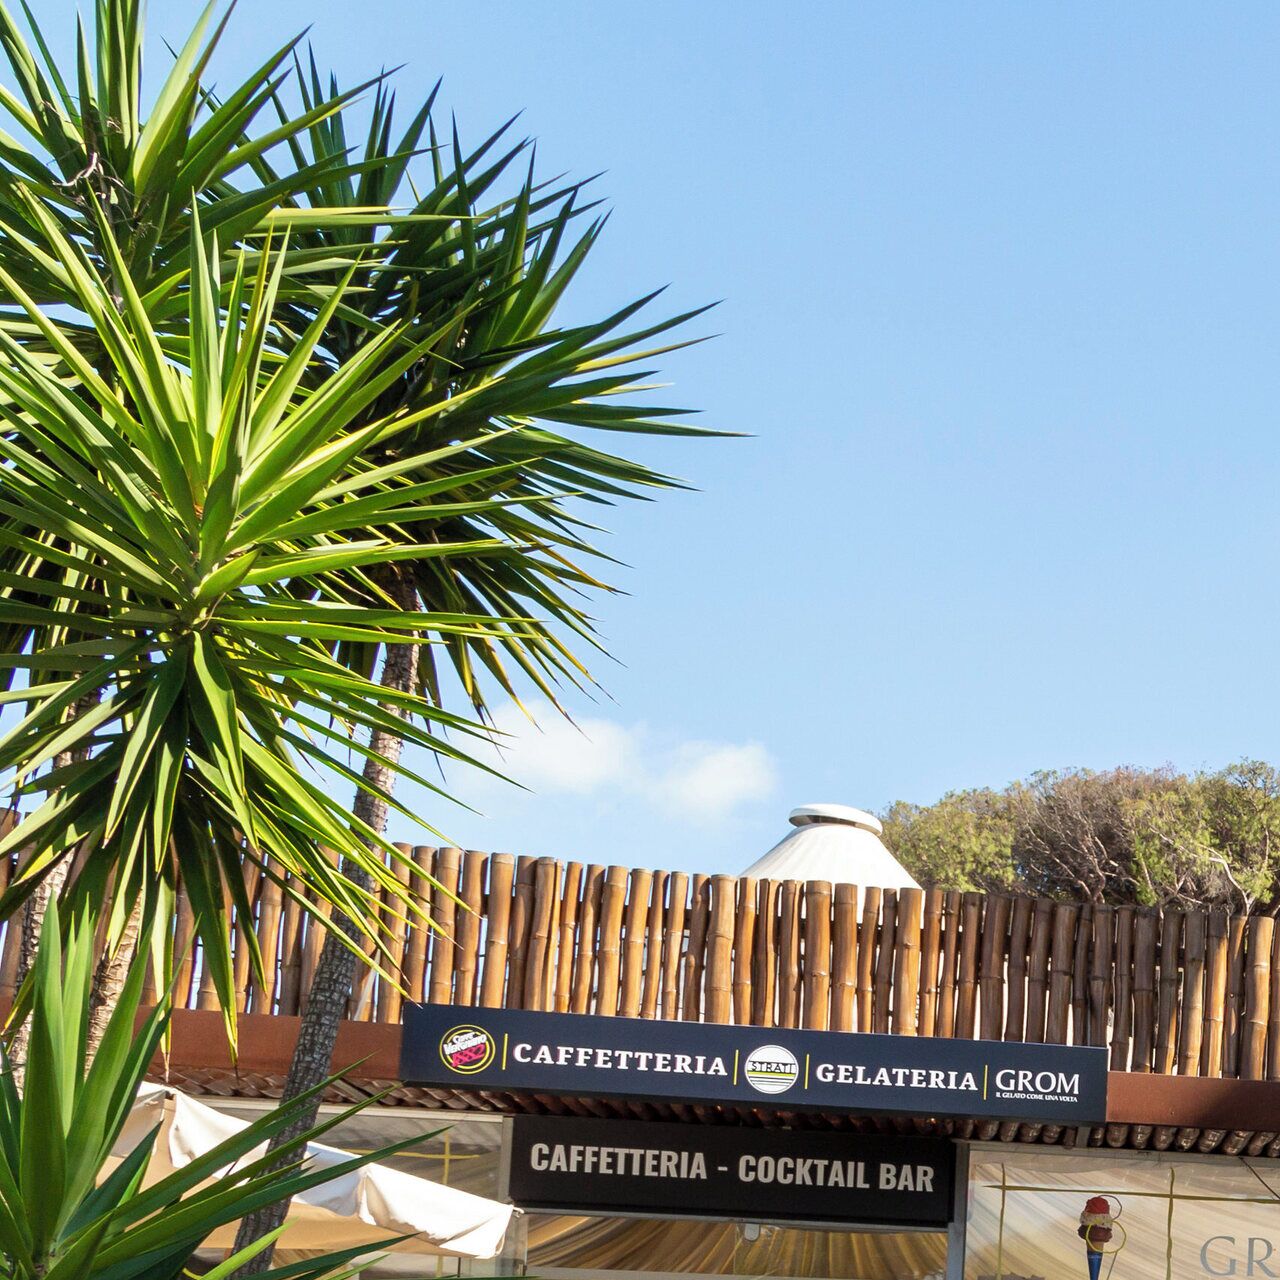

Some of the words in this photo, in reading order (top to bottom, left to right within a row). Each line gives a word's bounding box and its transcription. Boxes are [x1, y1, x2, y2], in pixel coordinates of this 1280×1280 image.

[513, 1043, 728, 1076] CAFFETTERIA
[751, 1061, 796, 1074] STRATI
[816, 1064, 978, 1091] GELATERIA
[996, 1069, 1079, 1094] GROM
[530, 1143, 708, 1180] CAFFETTERIA
[738, 1154, 870, 1190] COCKTAIL
[879, 1162, 935, 1194] BAR
